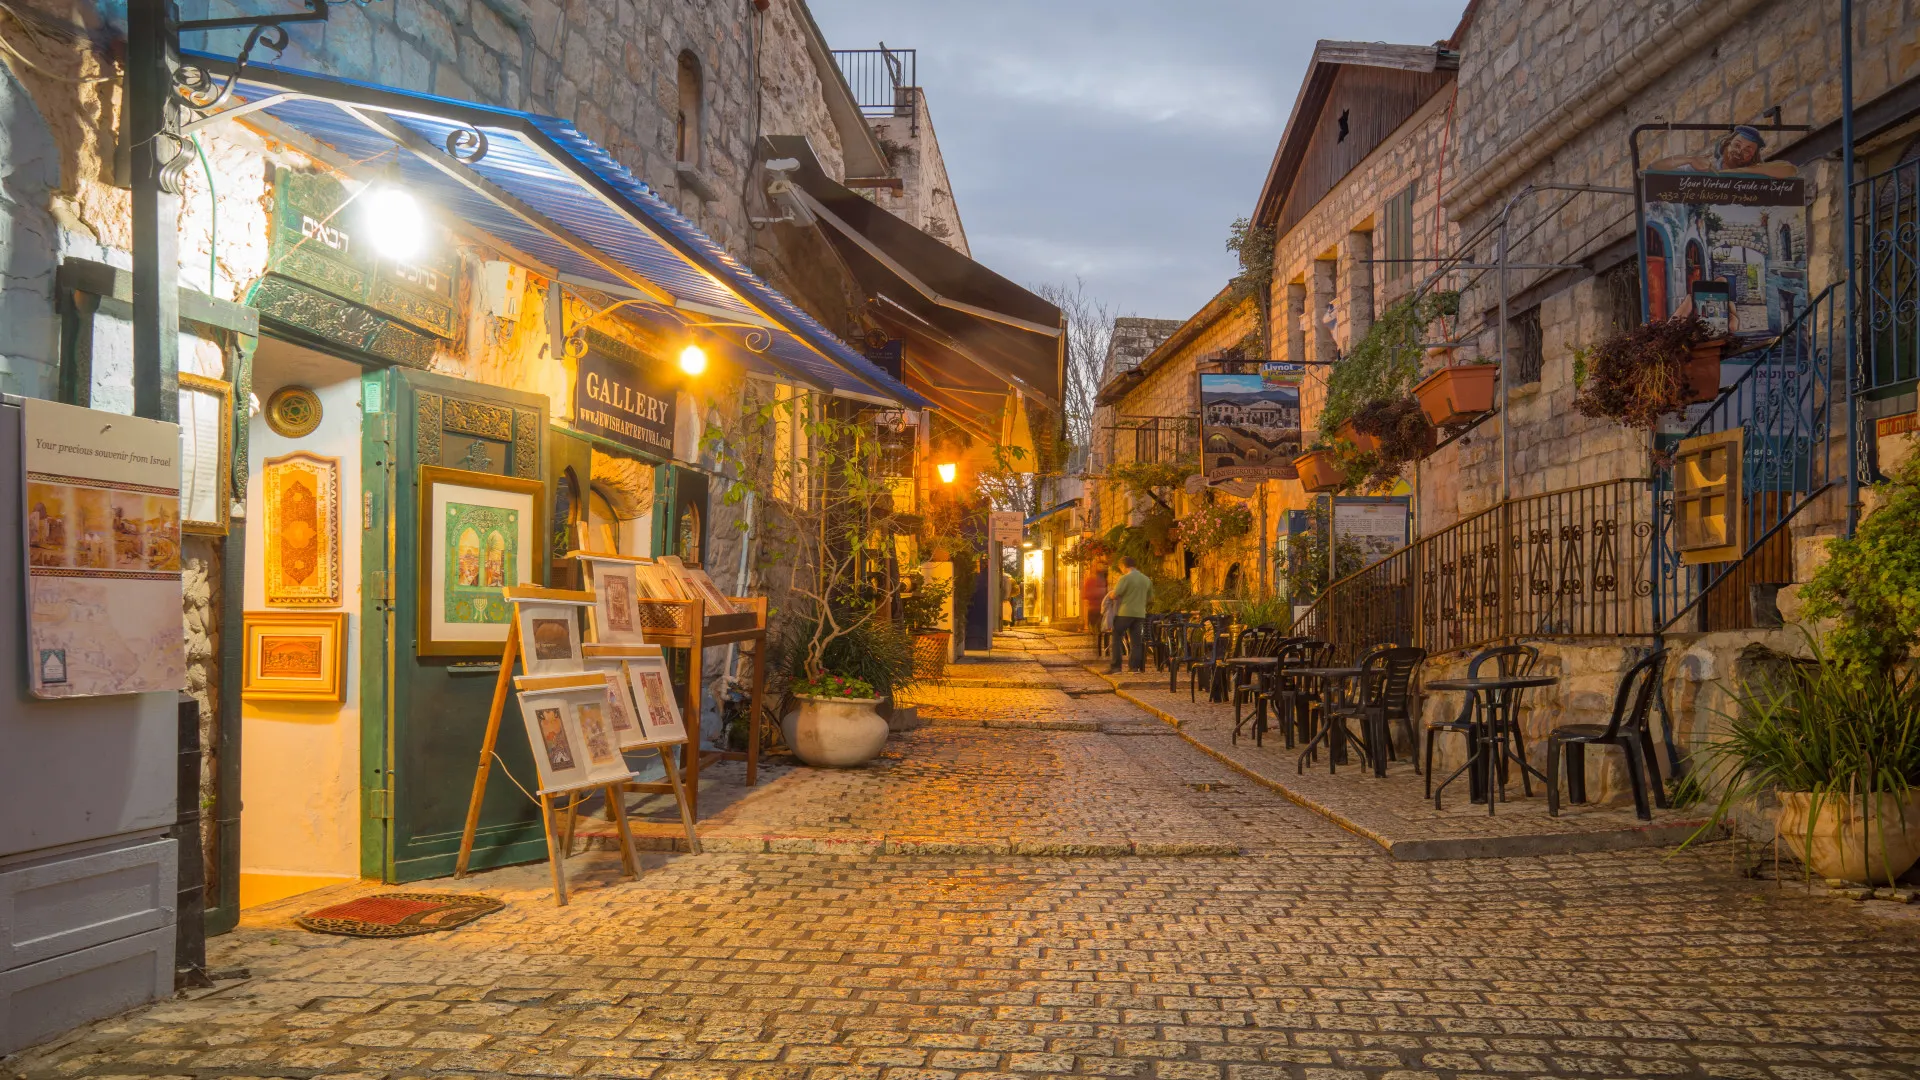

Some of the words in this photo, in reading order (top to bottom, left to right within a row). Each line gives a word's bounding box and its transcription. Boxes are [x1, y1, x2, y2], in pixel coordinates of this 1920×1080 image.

[1679, 177, 1701, 191] Your
[1702, 178, 1732, 189] Virtual
[1733, 180, 1758, 191] Guide
[1759, 182, 1768, 191] in
[1769, 180, 1795, 195] Safed
[301, 214, 350, 254] הבאים
[586, 371, 669, 425] GALLERY
[579, 407, 672, 450] WWW.JEWISHARTREVIVAL.COM
[36, 438, 57, 450] Your
[58, 444, 93, 455] precious
[94, 448, 127, 459] souvenir
[128, 451, 148, 464] from
[150, 455, 171, 467] Israel
